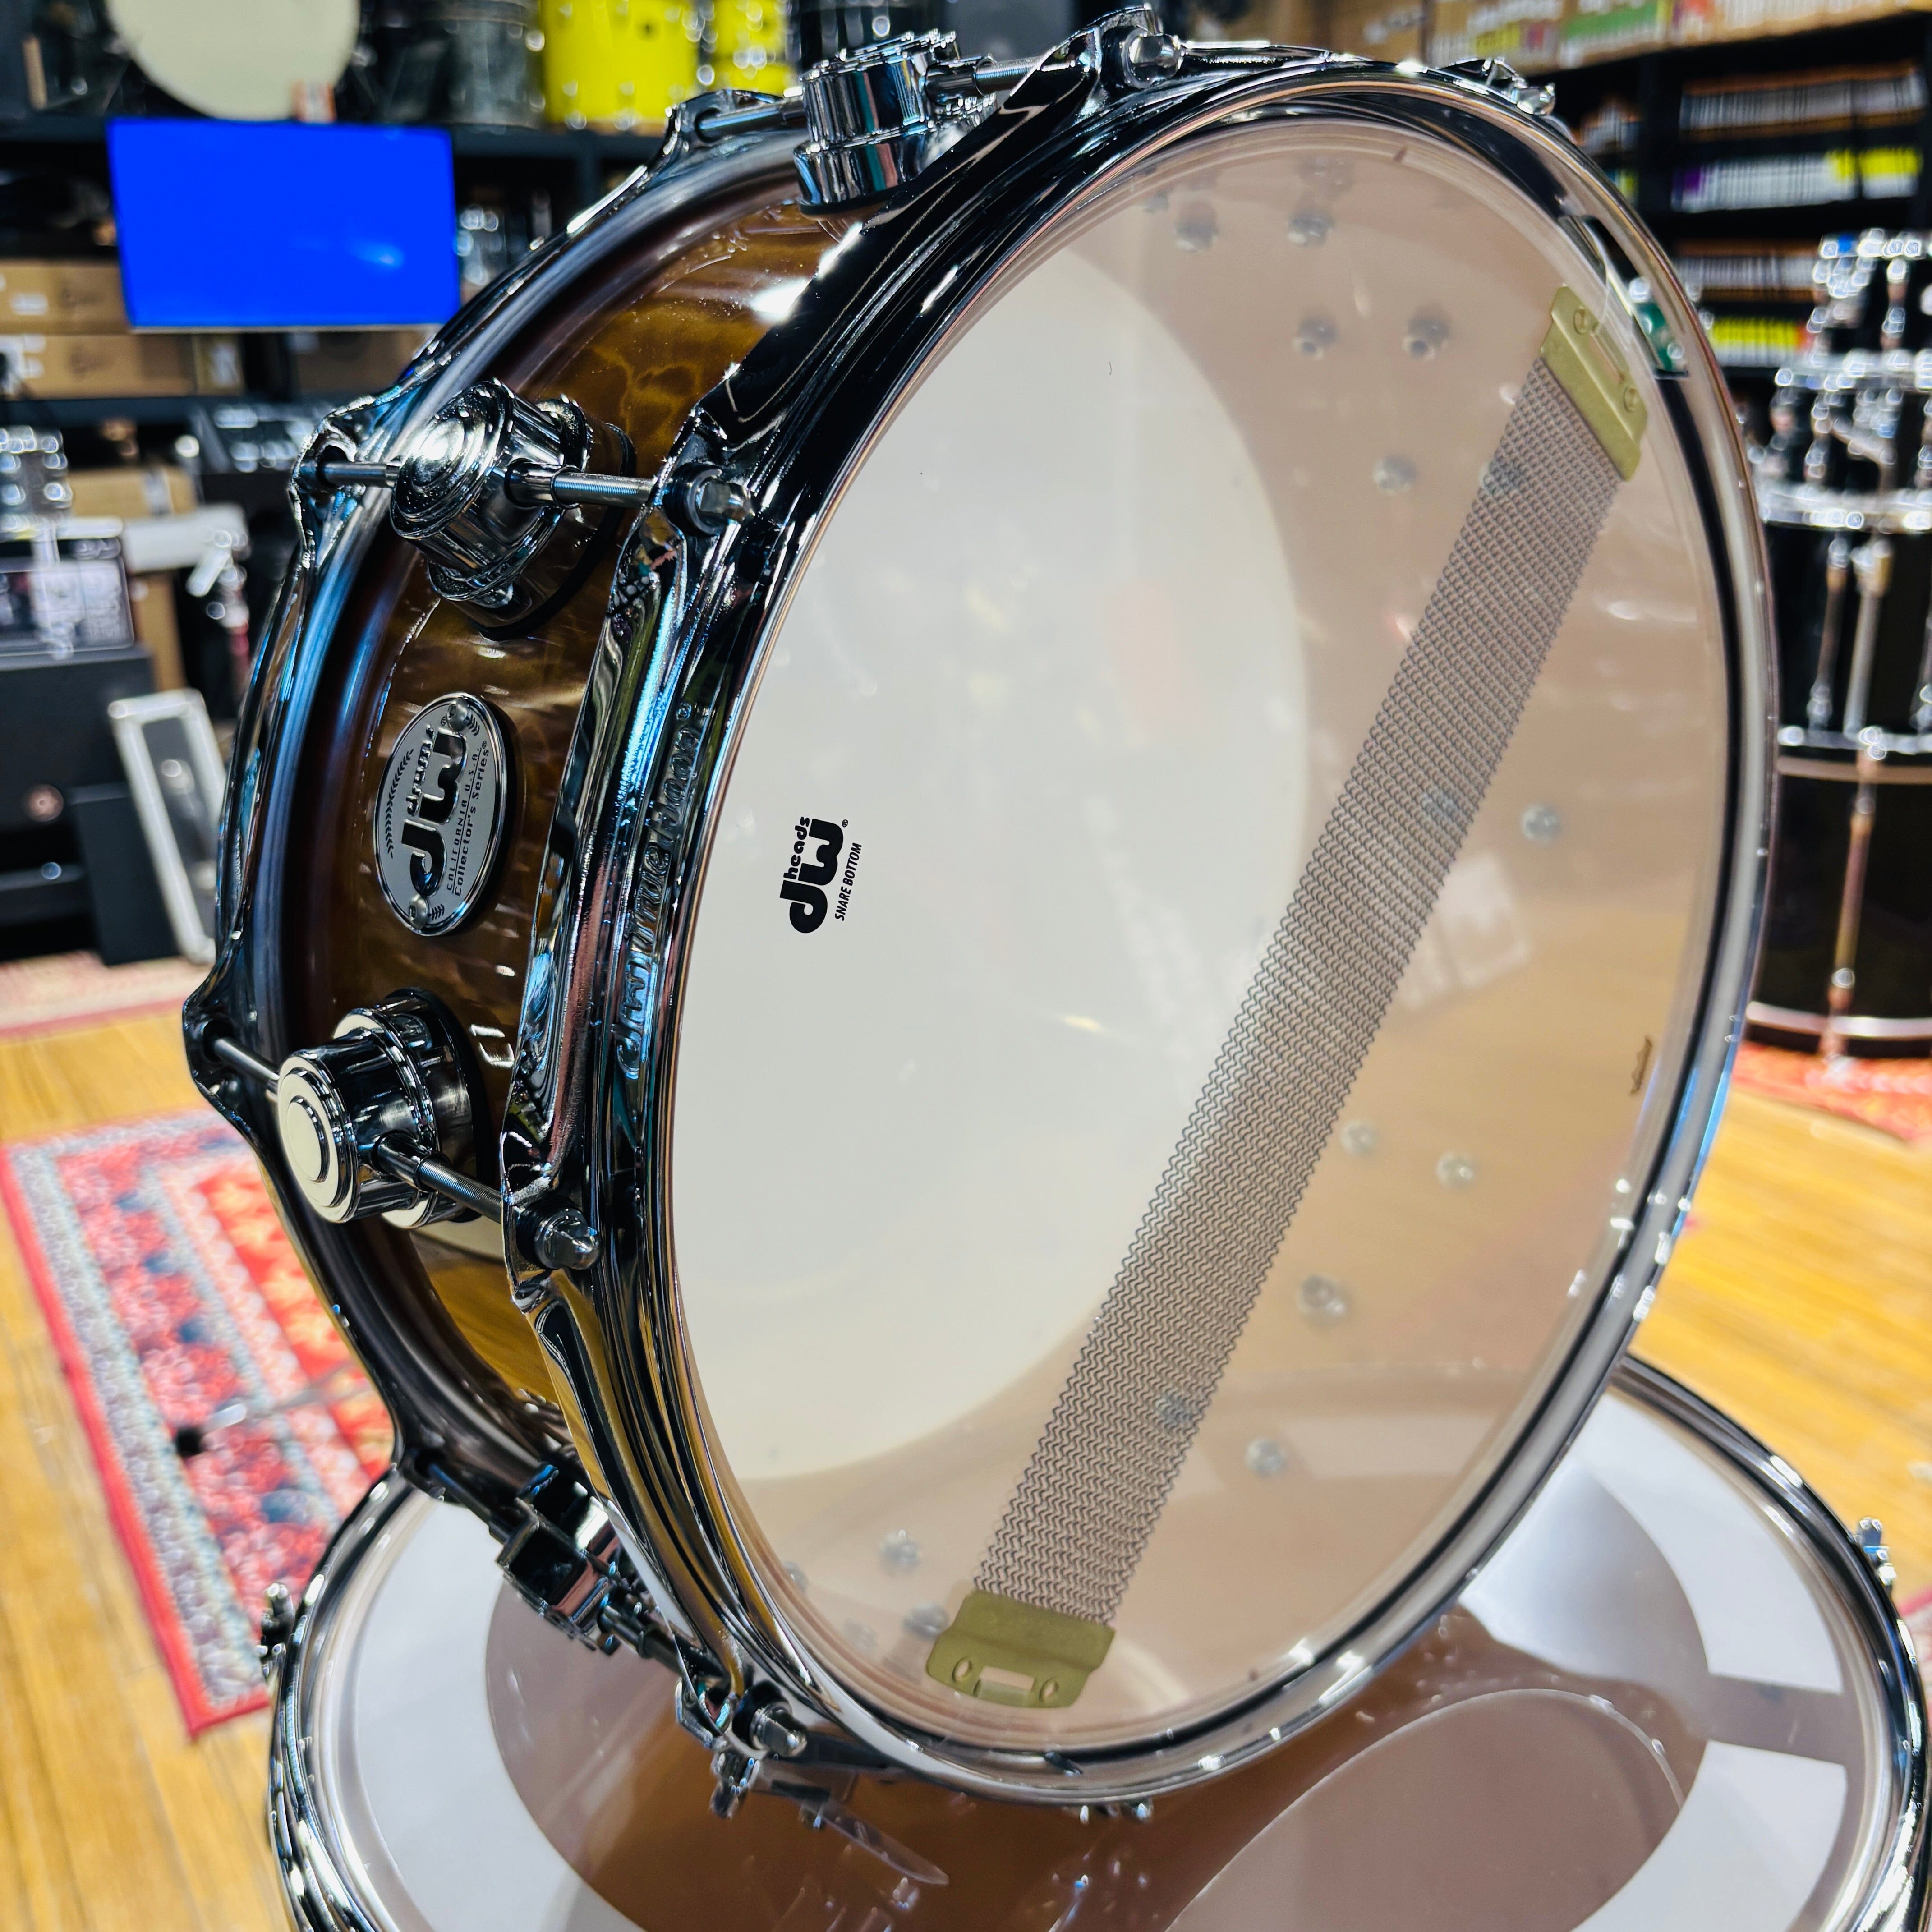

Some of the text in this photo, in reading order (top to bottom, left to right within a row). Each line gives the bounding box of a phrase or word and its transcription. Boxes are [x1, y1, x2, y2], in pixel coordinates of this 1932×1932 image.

[405, 724, 435, 817] drums
[447, 800, 468, 891] CALIFORNIA
[455, 806, 477, 897] Collector's
[780, 819, 843, 933] dw
[783, 817, 810, 879] heads
[835, 842, 862, 921] SNARE BOTTOM
